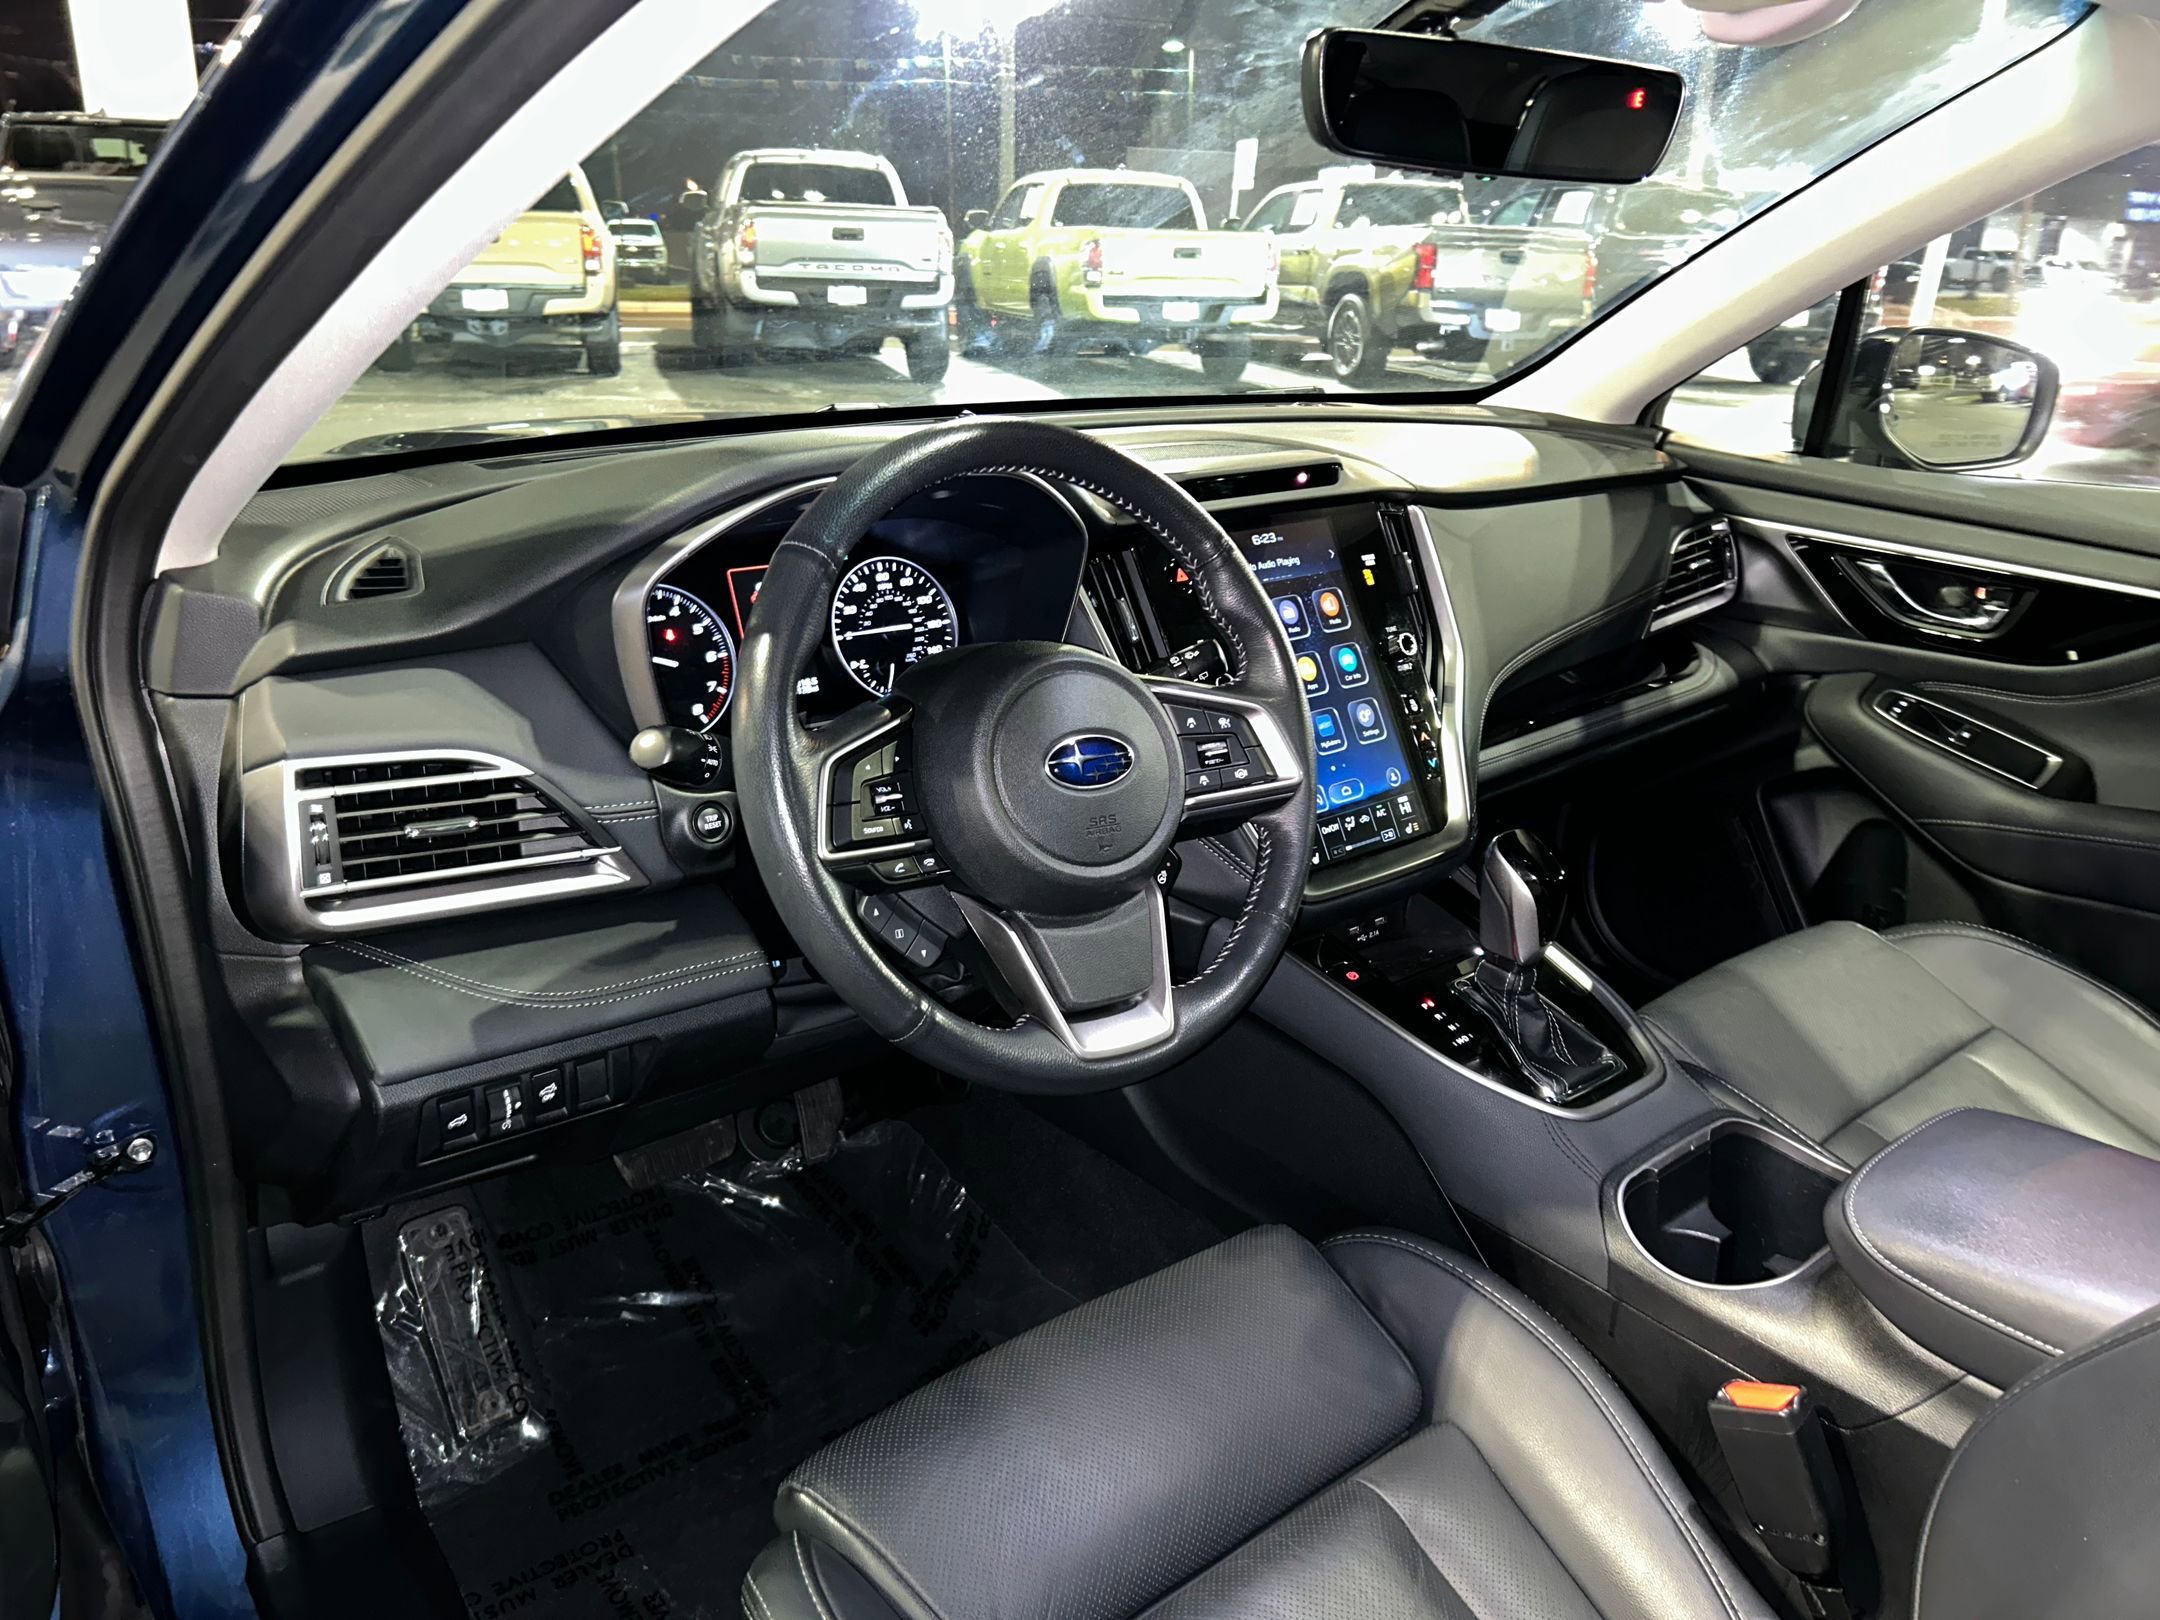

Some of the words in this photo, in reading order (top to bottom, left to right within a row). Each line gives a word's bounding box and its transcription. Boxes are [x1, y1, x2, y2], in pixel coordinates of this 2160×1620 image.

[798, 263, 900, 272] TACOMA
[1251, 532, 1277, 546] 6:23
[1258, 560, 1276, 570] Audio
[1276, 556, 1301, 568] Playing
[669, 606, 680, 616] 4
[692, 623, 704, 635] 5
[705, 651, 717, 663] 6
[706, 681, 717, 692] 7
[706, 758, 719, 767] AUTO
[1376, 808, 1388, 818] A/C
[1399, 802, 1413, 815] HI
[704, 814, 719, 823] TRIP
[1089, 814, 1117, 826] SRS
[704, 820, 722, 830] RESET
[863, 824, 884, 834] Source
[1086, 824, 1122, 837] AIRBAG
[1322, 823, 1340, 835] On/Off
[1447, 1023, 1457, 1031] N
[490, 1529, 625, 1597] PROTECTIVE
[551, 1543, 635, 1590] DEALER
